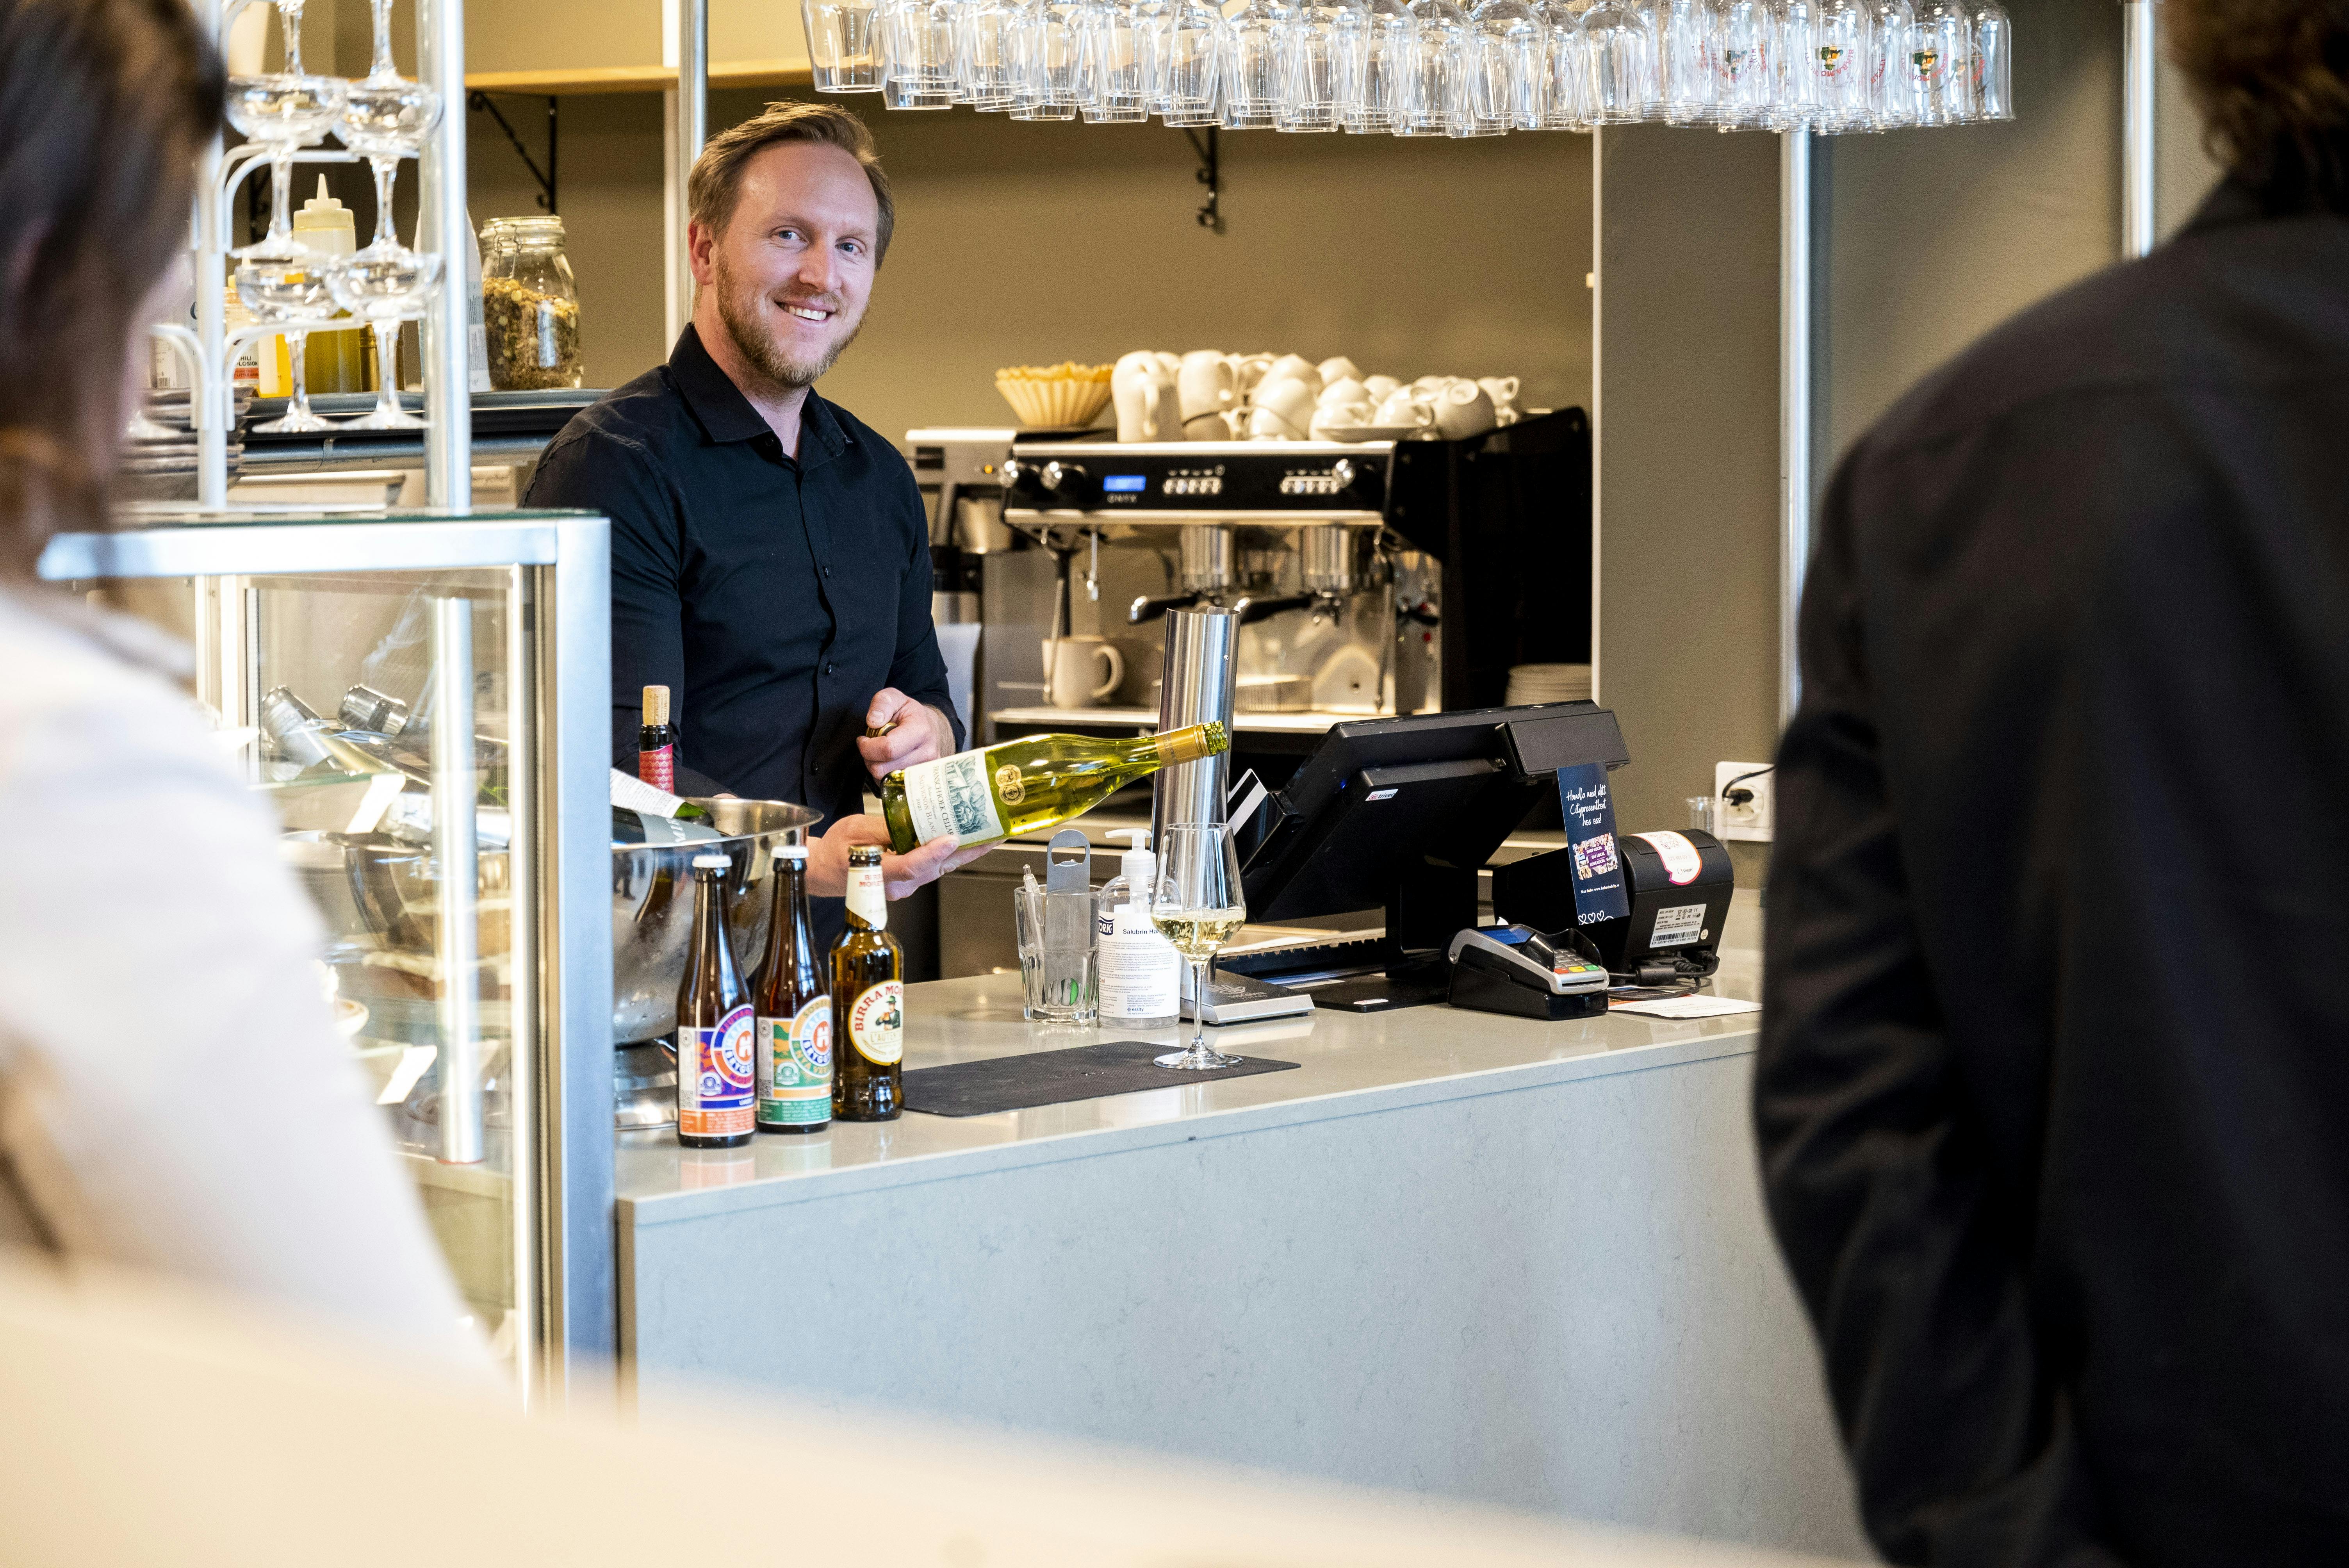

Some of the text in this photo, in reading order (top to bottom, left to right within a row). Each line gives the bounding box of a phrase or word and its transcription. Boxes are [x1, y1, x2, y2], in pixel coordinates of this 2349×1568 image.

[1566, 787, 1585, 802] Handla
[1587, 784, 1597, 798] med
[1570, 798, 1606, 818] Citypresentkort
[926, 812, 937, 834] BLANC
[1583, 813, 1601, 826] hos oss!
[855, 991, 883, 1032] BIRRA
